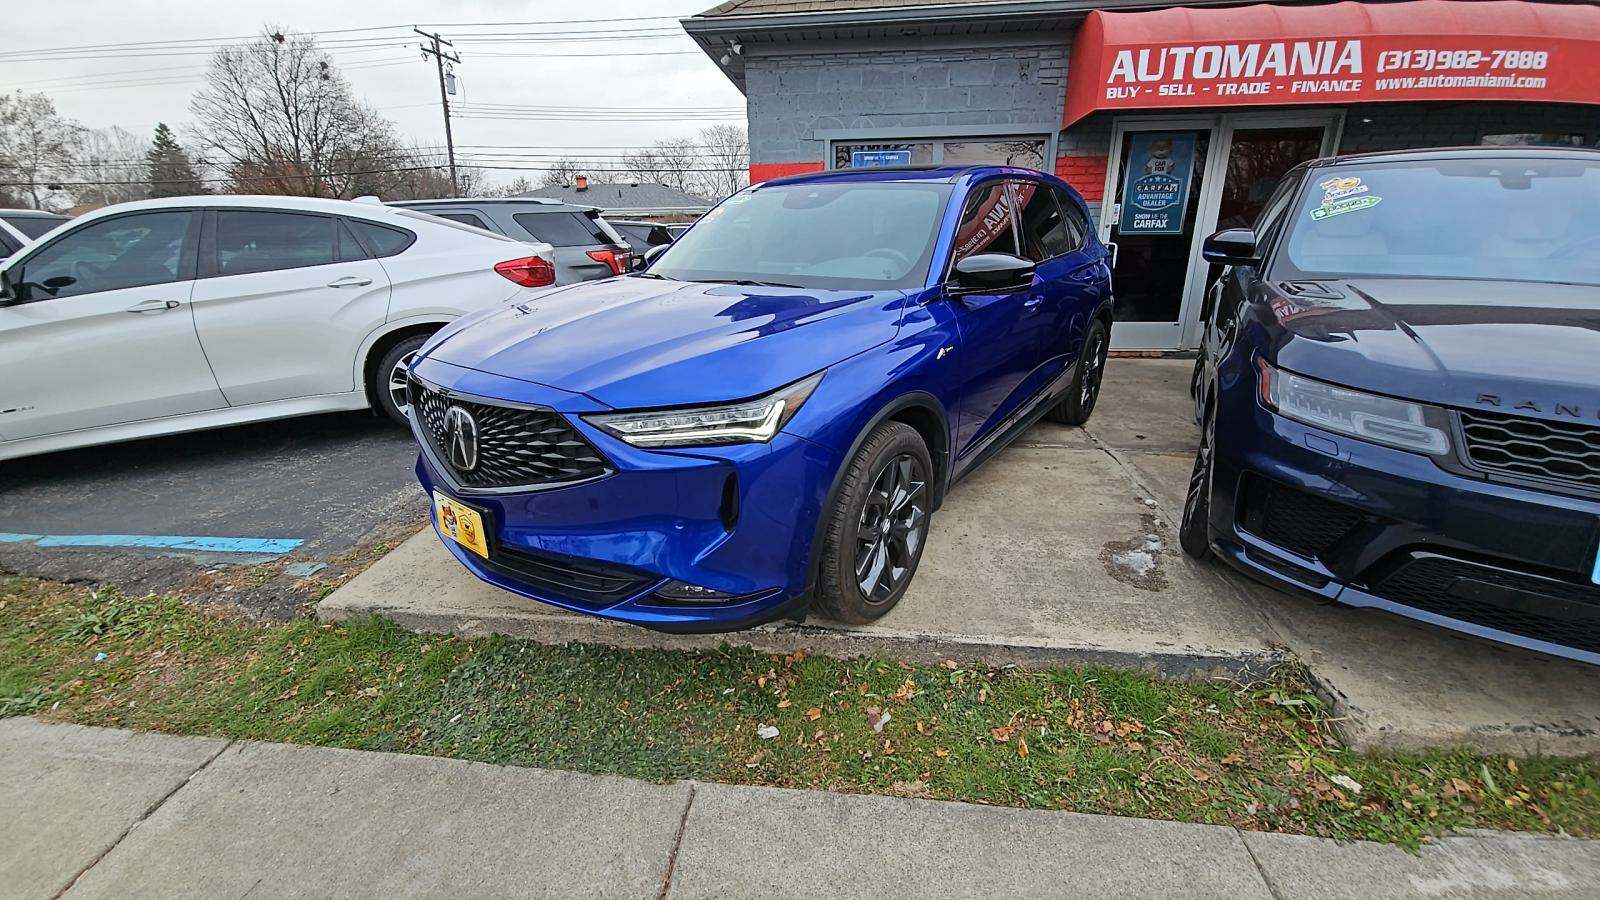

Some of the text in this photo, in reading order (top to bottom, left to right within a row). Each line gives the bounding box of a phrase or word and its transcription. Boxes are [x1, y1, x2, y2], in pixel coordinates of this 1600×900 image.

[1107, 40, 1362, 83] AUTOMANIA
[1376, 50, 1548, 72] (313)982-7888
[1106, 86, 1140, 99] BUY
[1159, 84, 1196, 96] SELL
[1216, 82, 1271, 95] TRADE
[1291, 80, 1363, 93] FINANCE
[1375, 73, 1547, 90] www.automaniami.com
[1133, 219, 1168, 228] CARFAX
[1476, 392, 1600, 420] RAN
